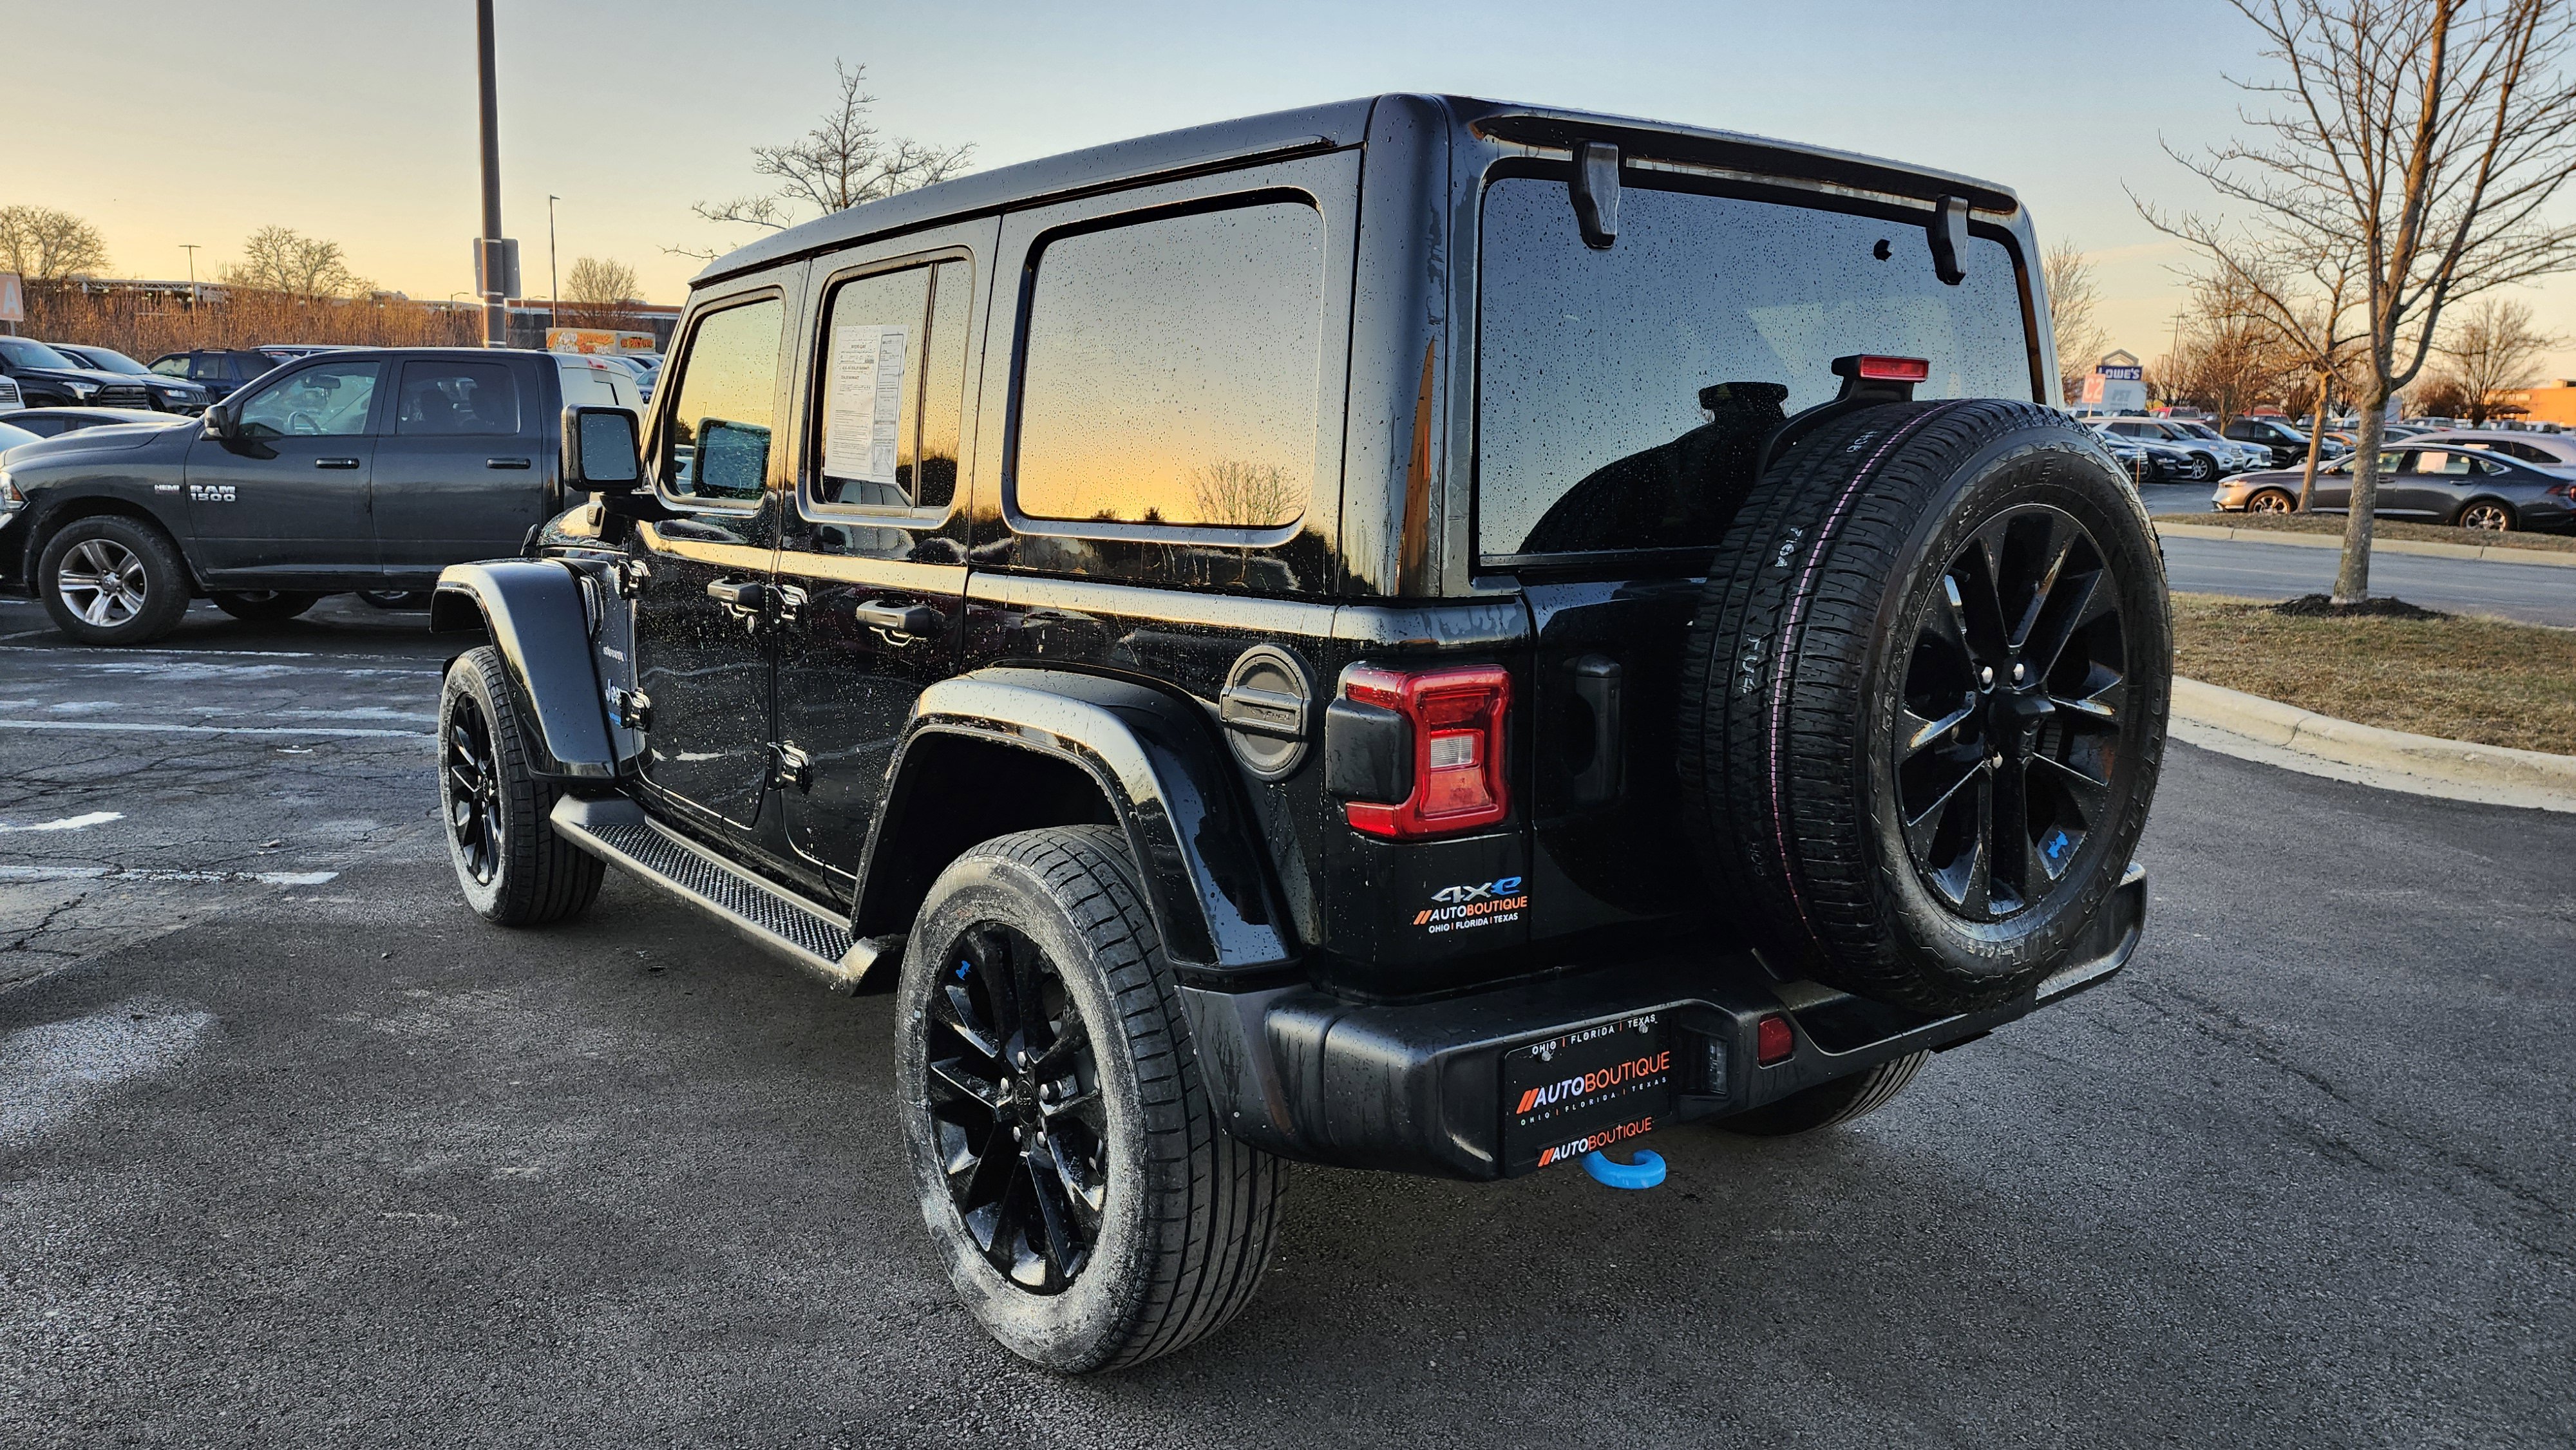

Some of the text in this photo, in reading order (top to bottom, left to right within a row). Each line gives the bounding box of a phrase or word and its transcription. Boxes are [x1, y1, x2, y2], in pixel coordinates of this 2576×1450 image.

[3, 281, 20, 314] A
[2085, 377, 2103, 399] C2
[189, 485, 236, 494] RAM
[190, 493, 236, 502] 1500
[605, 678, 622, 706] Jee
[1430, 876, 1522, 903] 4xe
[1428, 912, 1519, 934] OHIO FLORIDA TEXAS
[1531, 1013, 1656, 1055] OHIO FLORIDA TEXAS
[1520, 1077, 1667, 1126] OHIO FLORIDA TEXAS
